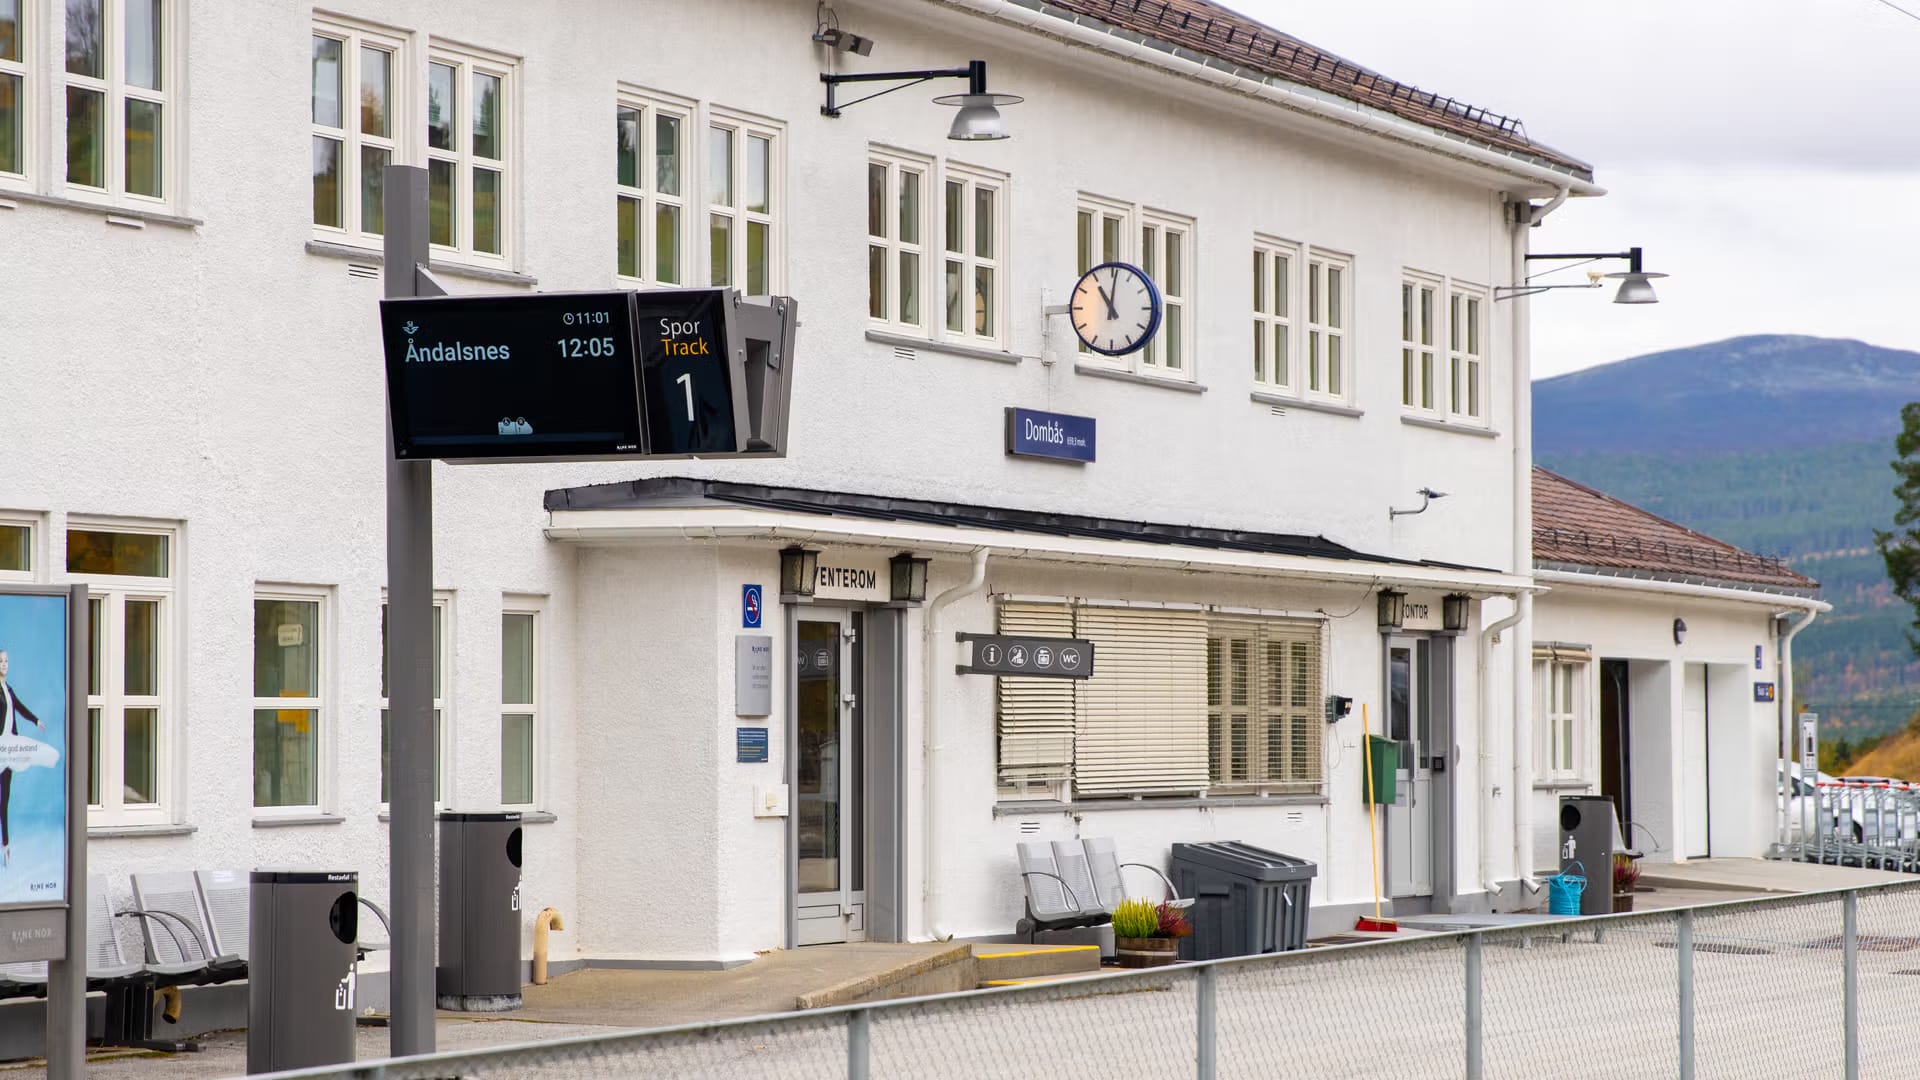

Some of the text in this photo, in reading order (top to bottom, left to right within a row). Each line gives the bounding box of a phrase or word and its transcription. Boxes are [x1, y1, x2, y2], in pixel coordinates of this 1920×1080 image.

[576, 311, 609, 324] 11:01
[660, 318, 700, 339] Spor
[405, 338, 510, 362] Åndalsnes
[557, 337, 615, 358] 12:05
[661, 337, 709, 356] Track
[676, 373, 695, 421] 1
[1025, 418, 1064, 444] Dombås
[1404, 603, 1429, 620] ONTOR
[1062, 653, 1078, 664] WC
